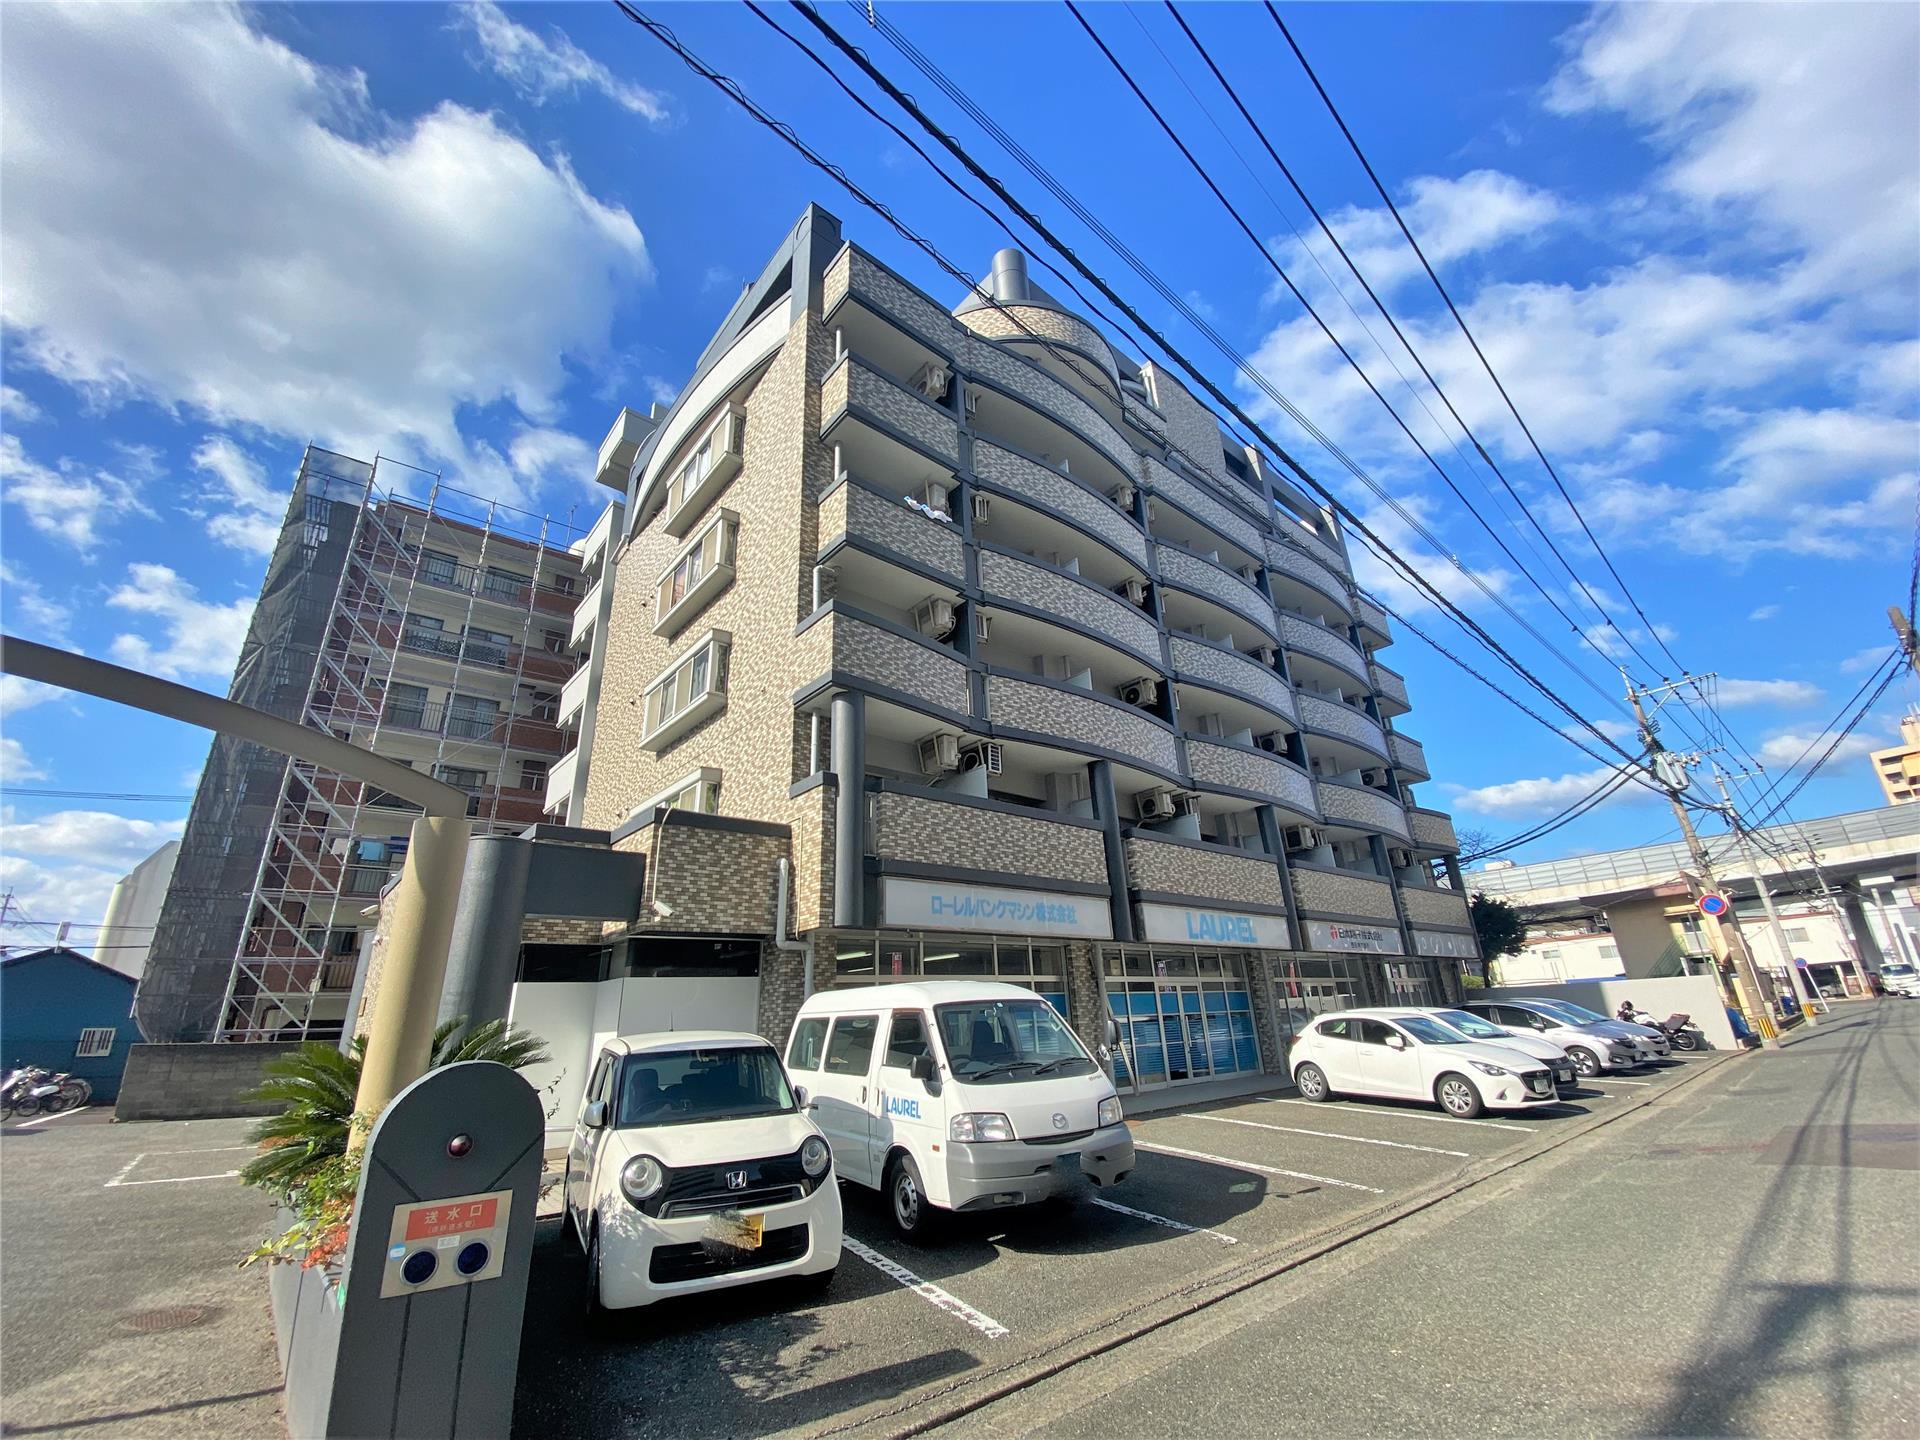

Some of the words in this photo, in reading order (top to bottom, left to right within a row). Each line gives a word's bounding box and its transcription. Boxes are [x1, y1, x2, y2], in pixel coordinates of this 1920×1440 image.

[931, 895, 1078, 924] ローレルバンクマシン株式会社
[1185, 911, 1258, 943] LAUREL
[886, 1095, 922, 1119] LAUREL
[424, 1204, 482, 1224] 送水口
